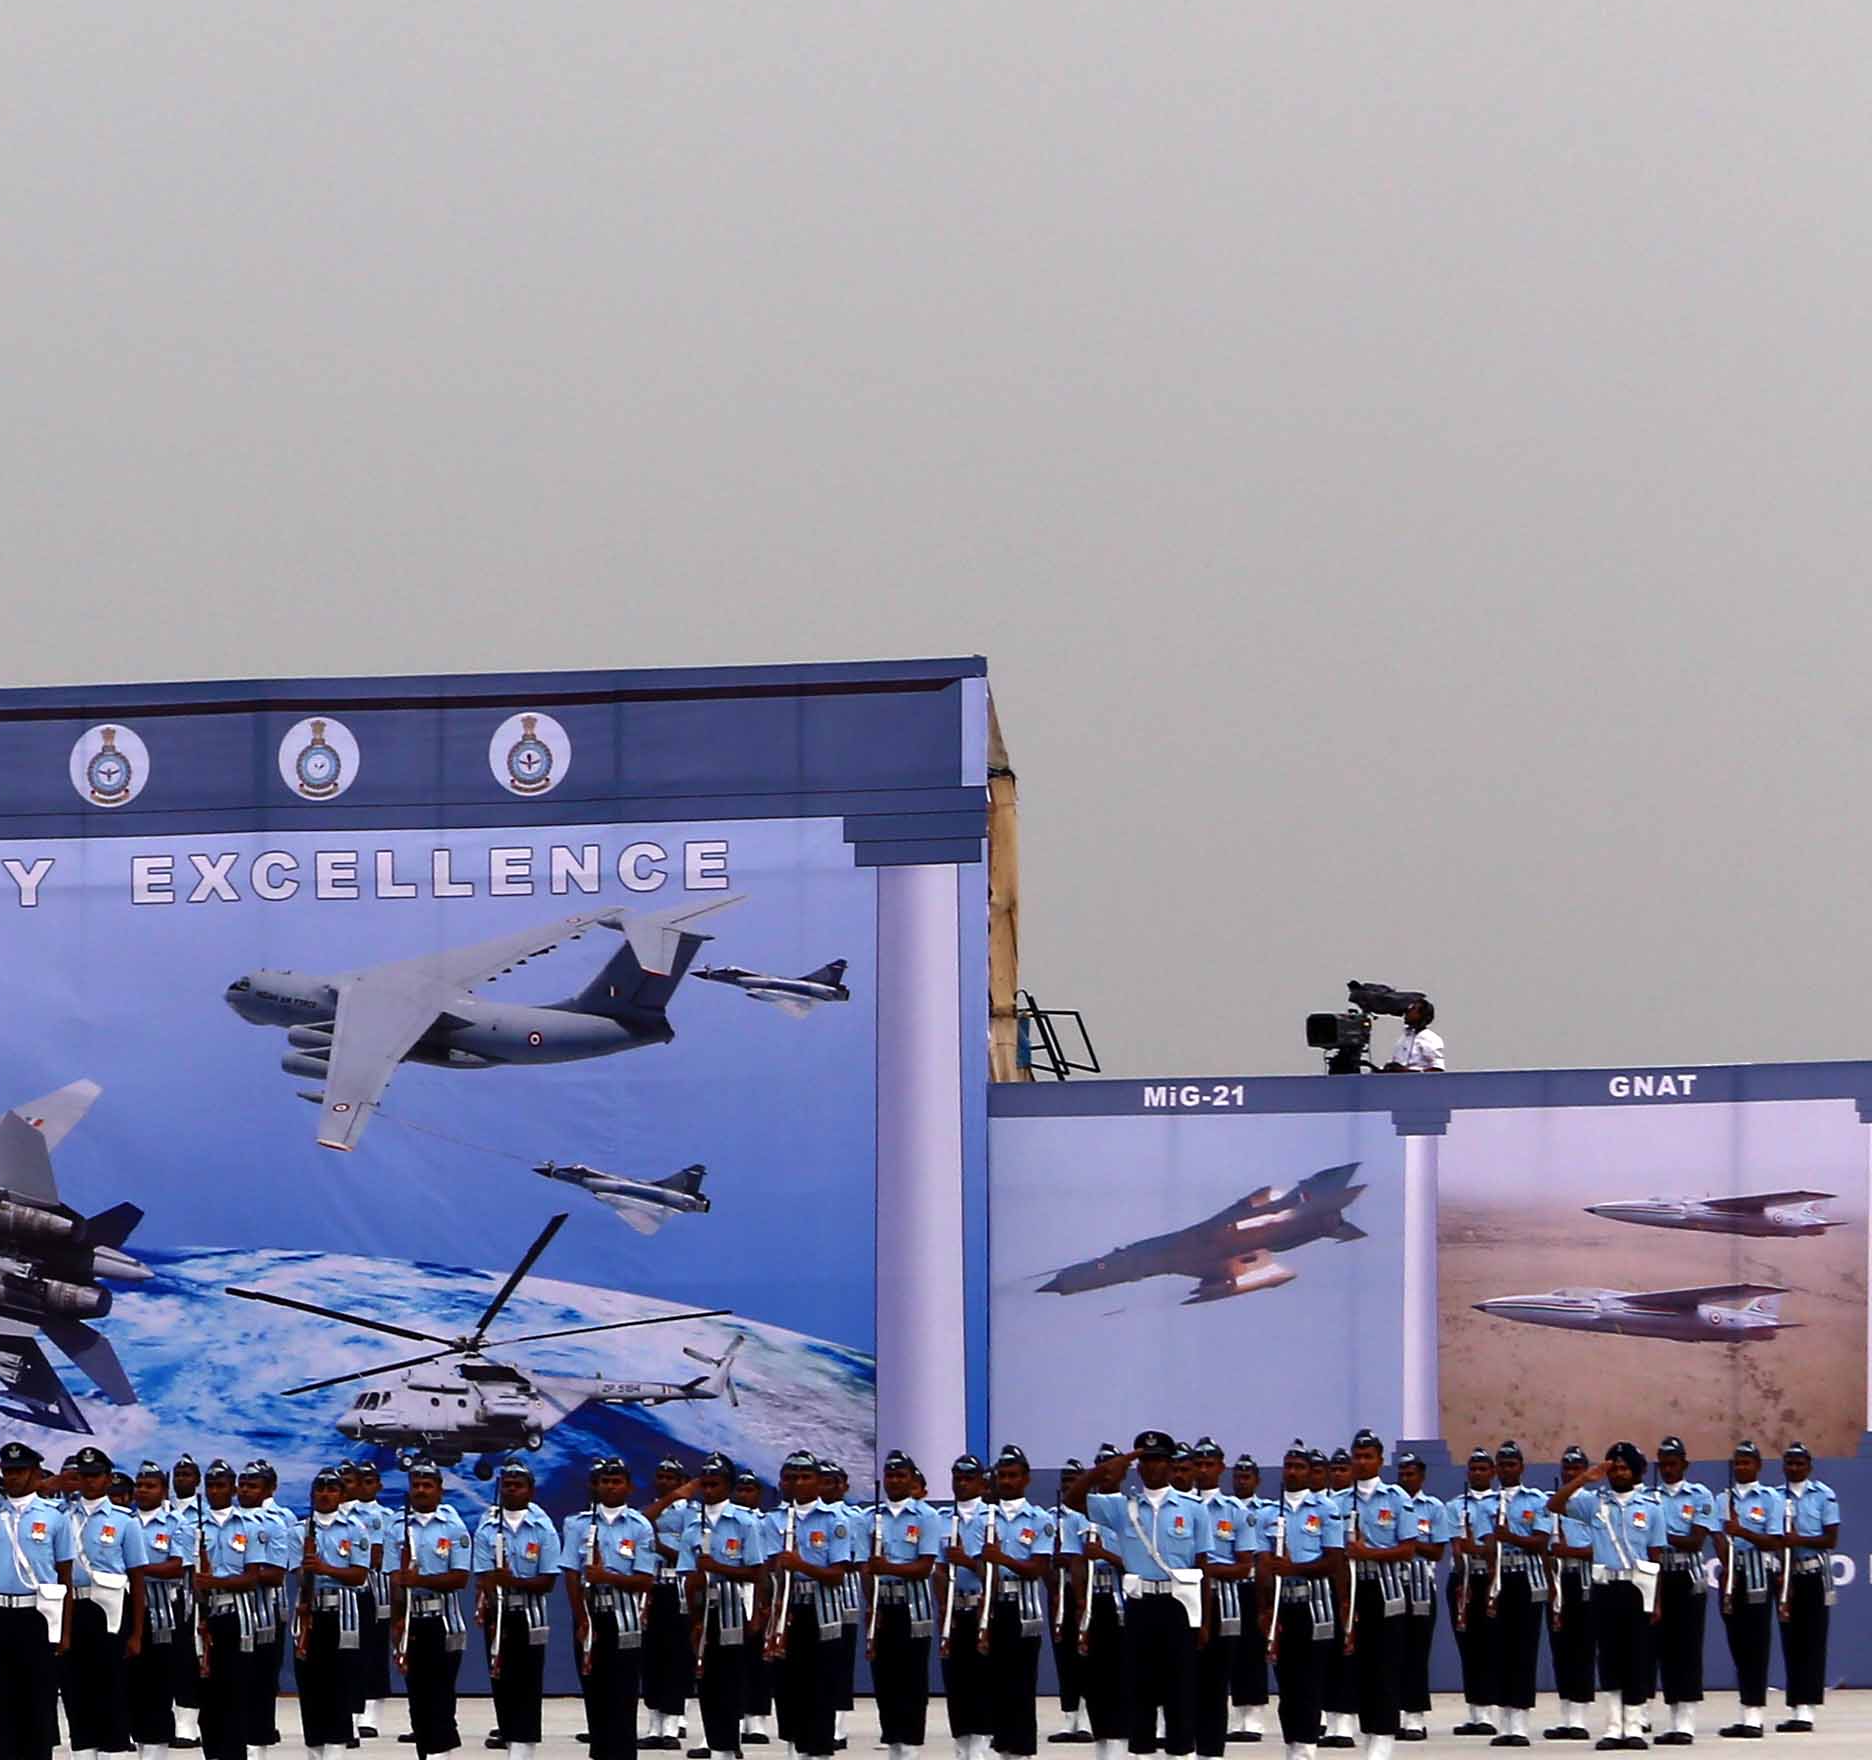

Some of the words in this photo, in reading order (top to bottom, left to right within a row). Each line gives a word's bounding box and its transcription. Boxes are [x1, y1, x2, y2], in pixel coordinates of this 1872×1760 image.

[130, 840, 730, 905] EXCELLENCE
[1143, 1085, 1245, 1107] MiG-21
[1608, 1074, 1698, 1097] GNAT
